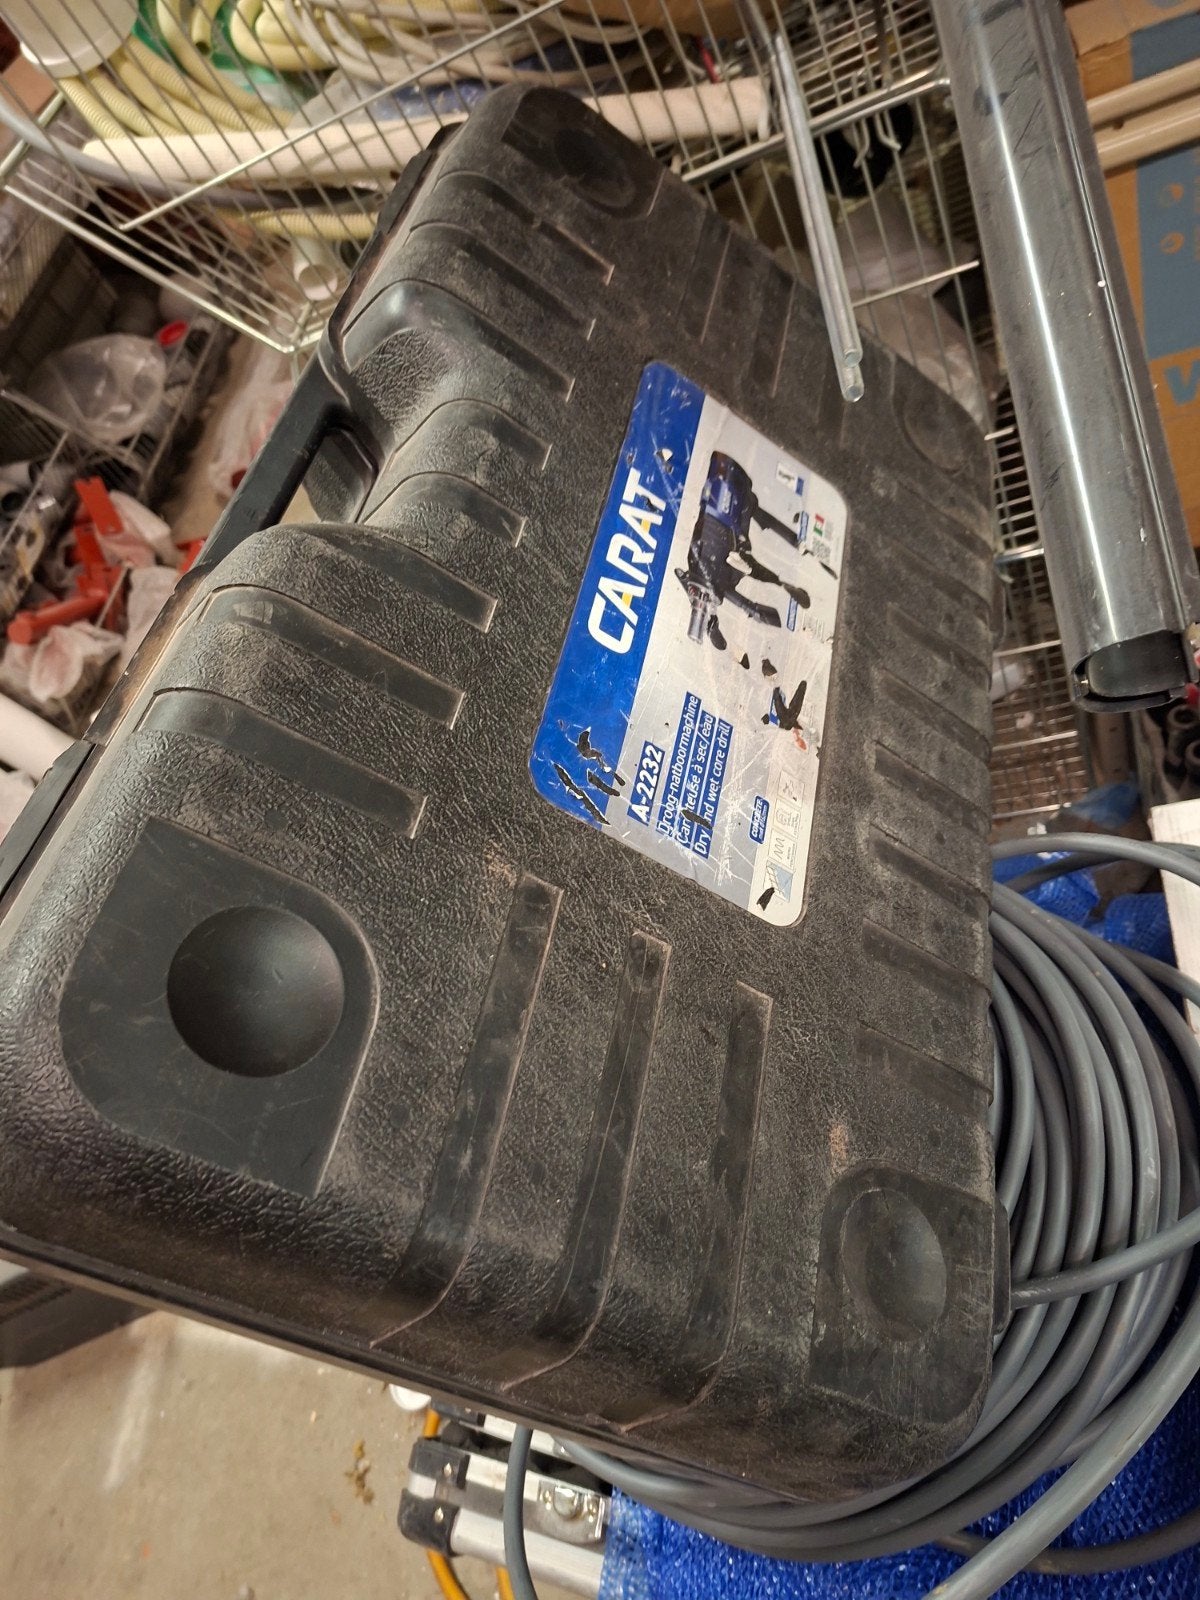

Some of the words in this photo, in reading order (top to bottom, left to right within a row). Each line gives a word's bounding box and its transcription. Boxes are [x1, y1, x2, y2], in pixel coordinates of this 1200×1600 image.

[588, 468, 666, 654] CARAT
[717, 721, 731, 749] drill
[631, 744, 662, 822] A-2232
[657, 695, 699, 835] Droog-natboormachine
[677, 774, 701, 844] Carteuse
[691, 763, 703, 774] à
[697, 713, 714, 763] sec/eau
[708, 777, 720, 802] wet
[712, 749, 725, 777] core
[695, 829, 711, 855] Dry
